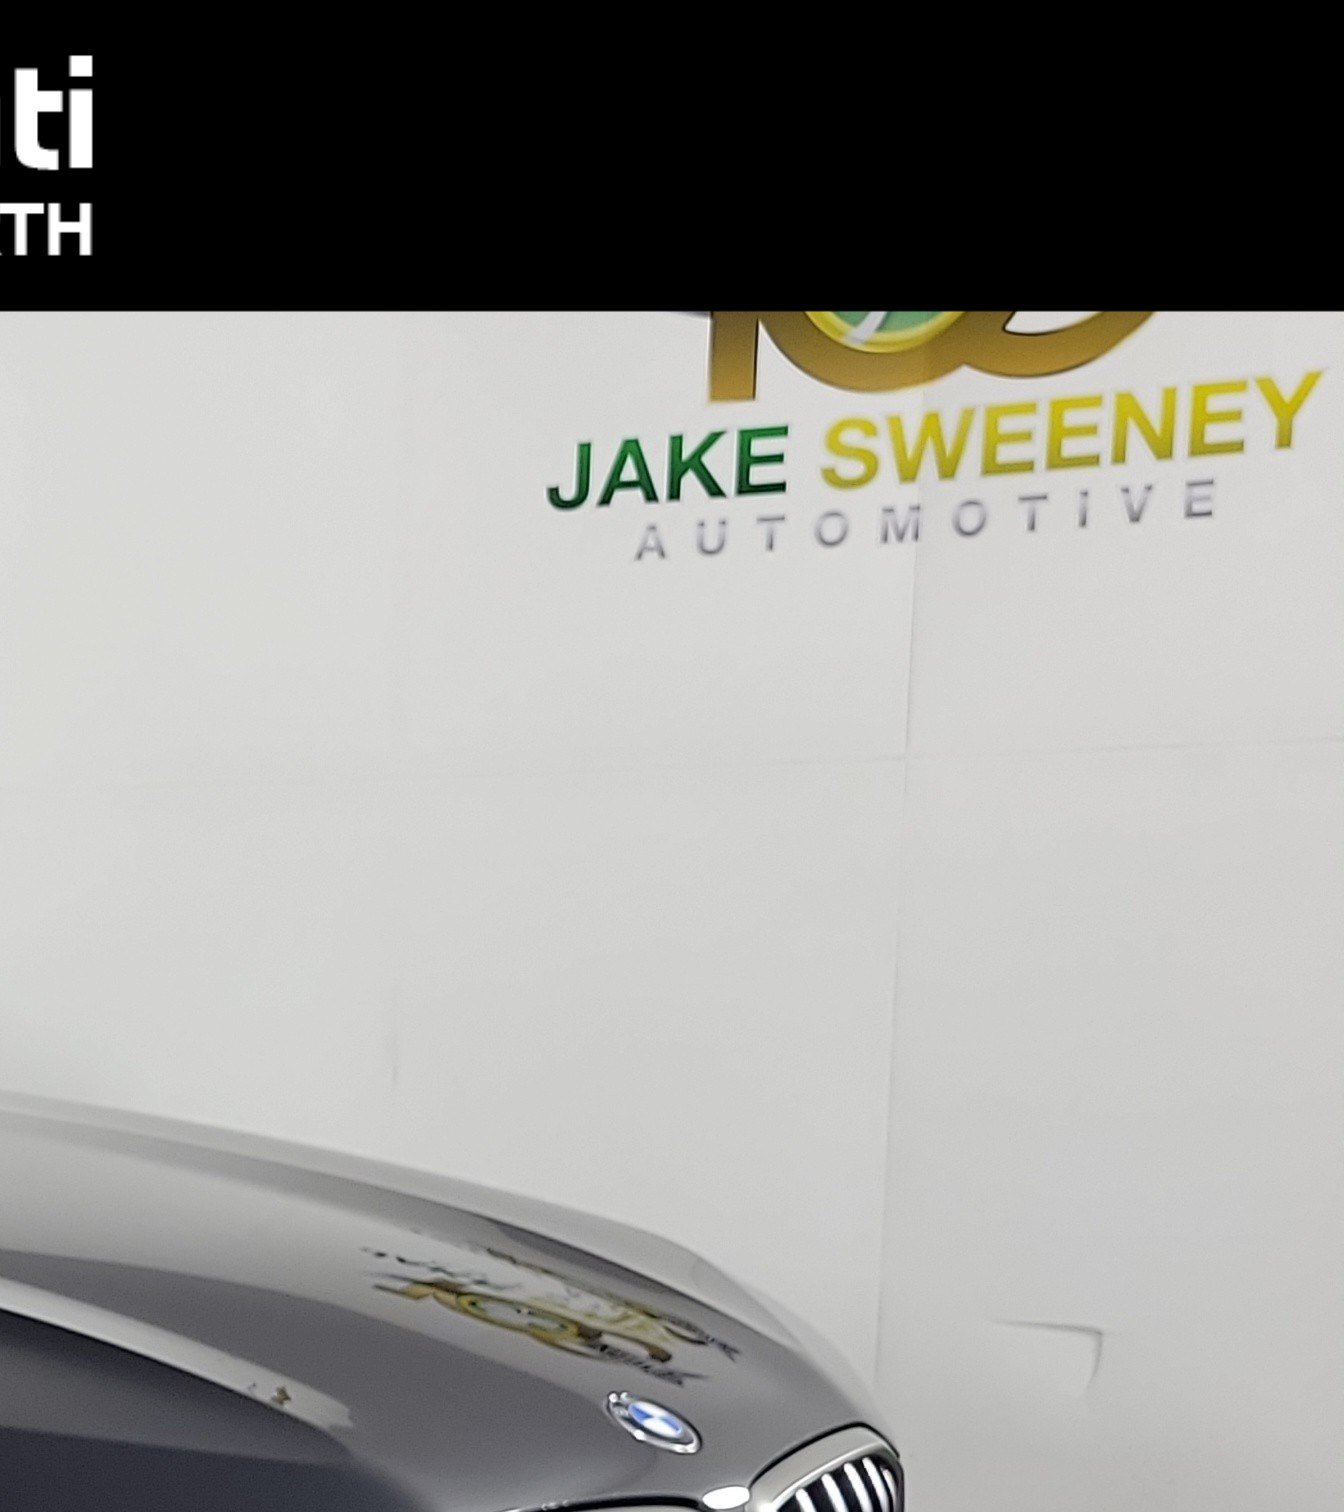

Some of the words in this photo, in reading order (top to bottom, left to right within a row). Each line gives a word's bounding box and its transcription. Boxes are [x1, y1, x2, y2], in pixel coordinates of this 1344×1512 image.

[547, 424, 790, 511] JAKE
[820, 370, 1325, 490] SWEENEY
[633, 478, 1218, 562] AUTOMOTIVE
